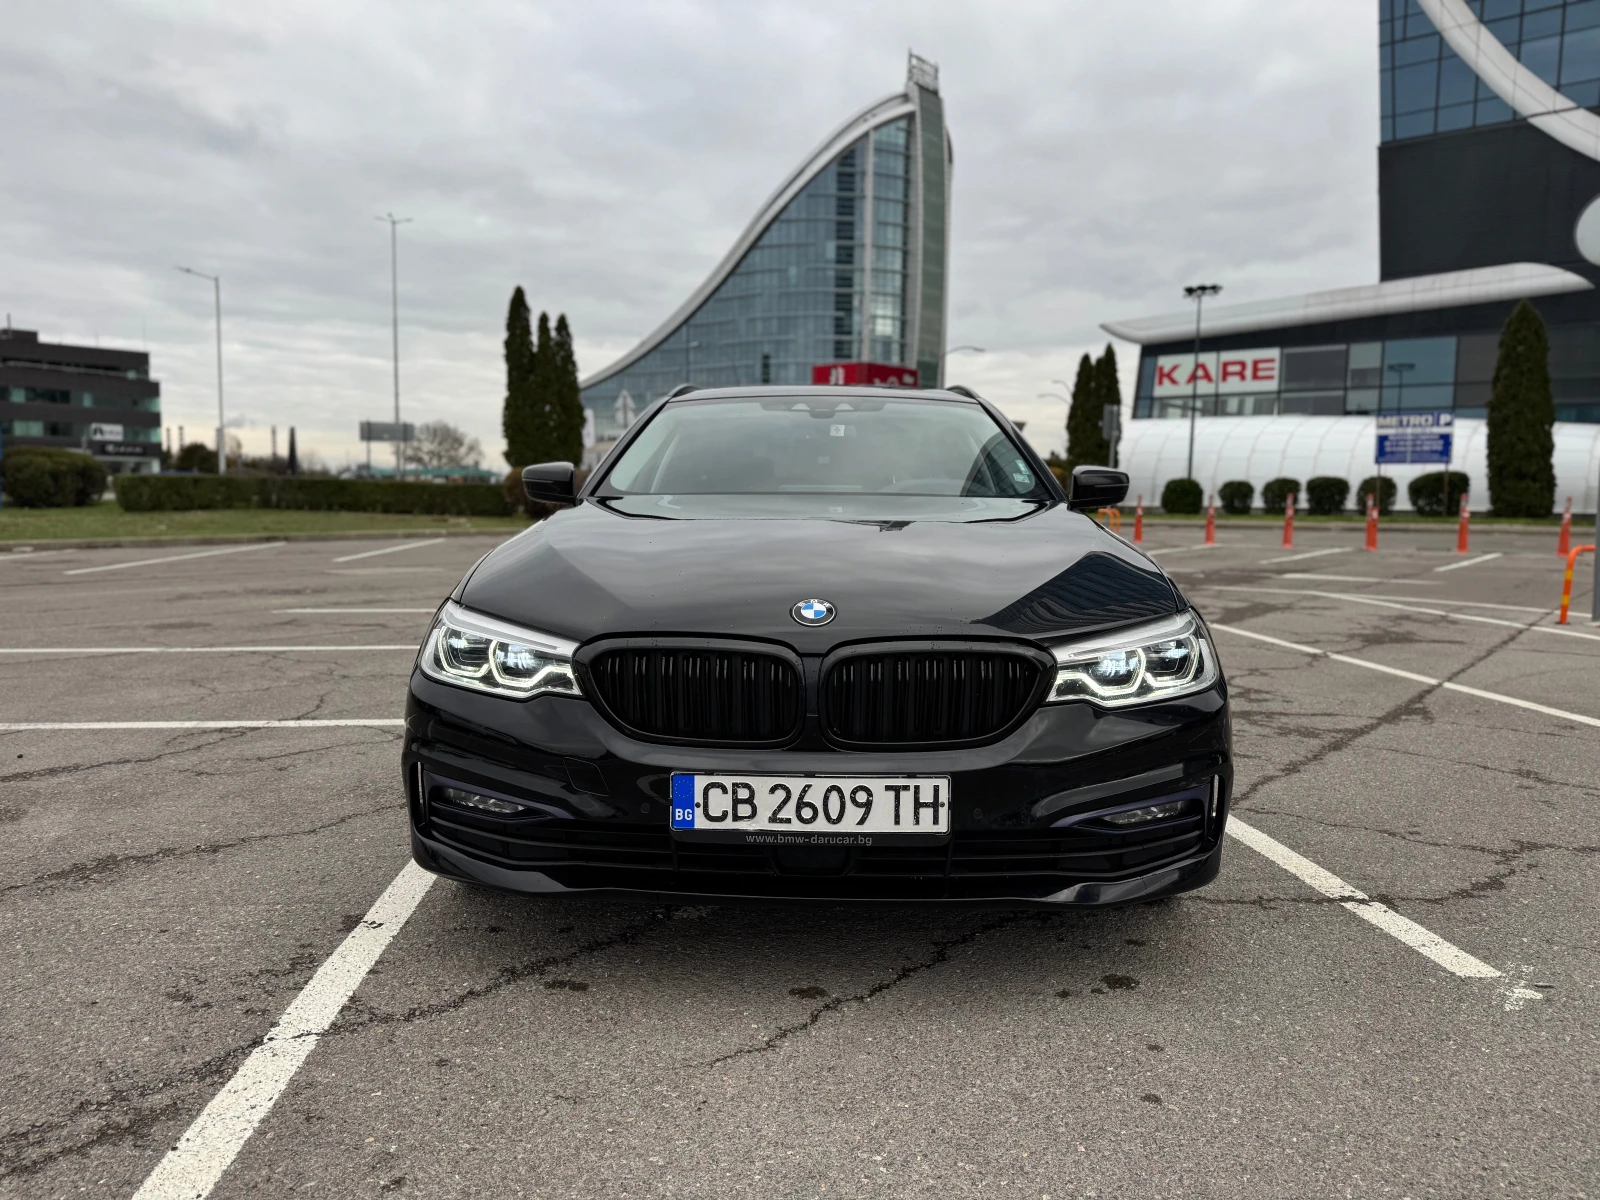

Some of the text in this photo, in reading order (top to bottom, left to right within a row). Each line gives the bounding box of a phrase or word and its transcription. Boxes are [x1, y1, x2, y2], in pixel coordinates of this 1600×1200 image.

[1157, 358, 1276, 387] KARE
[1377, 414, 1434, 428] METRO
[702, 781, 941, 826] CB 2609 TH
[674, 807, 693, 821] BG
[745, 833, 873, 847] www.bmw-darucar.bg
